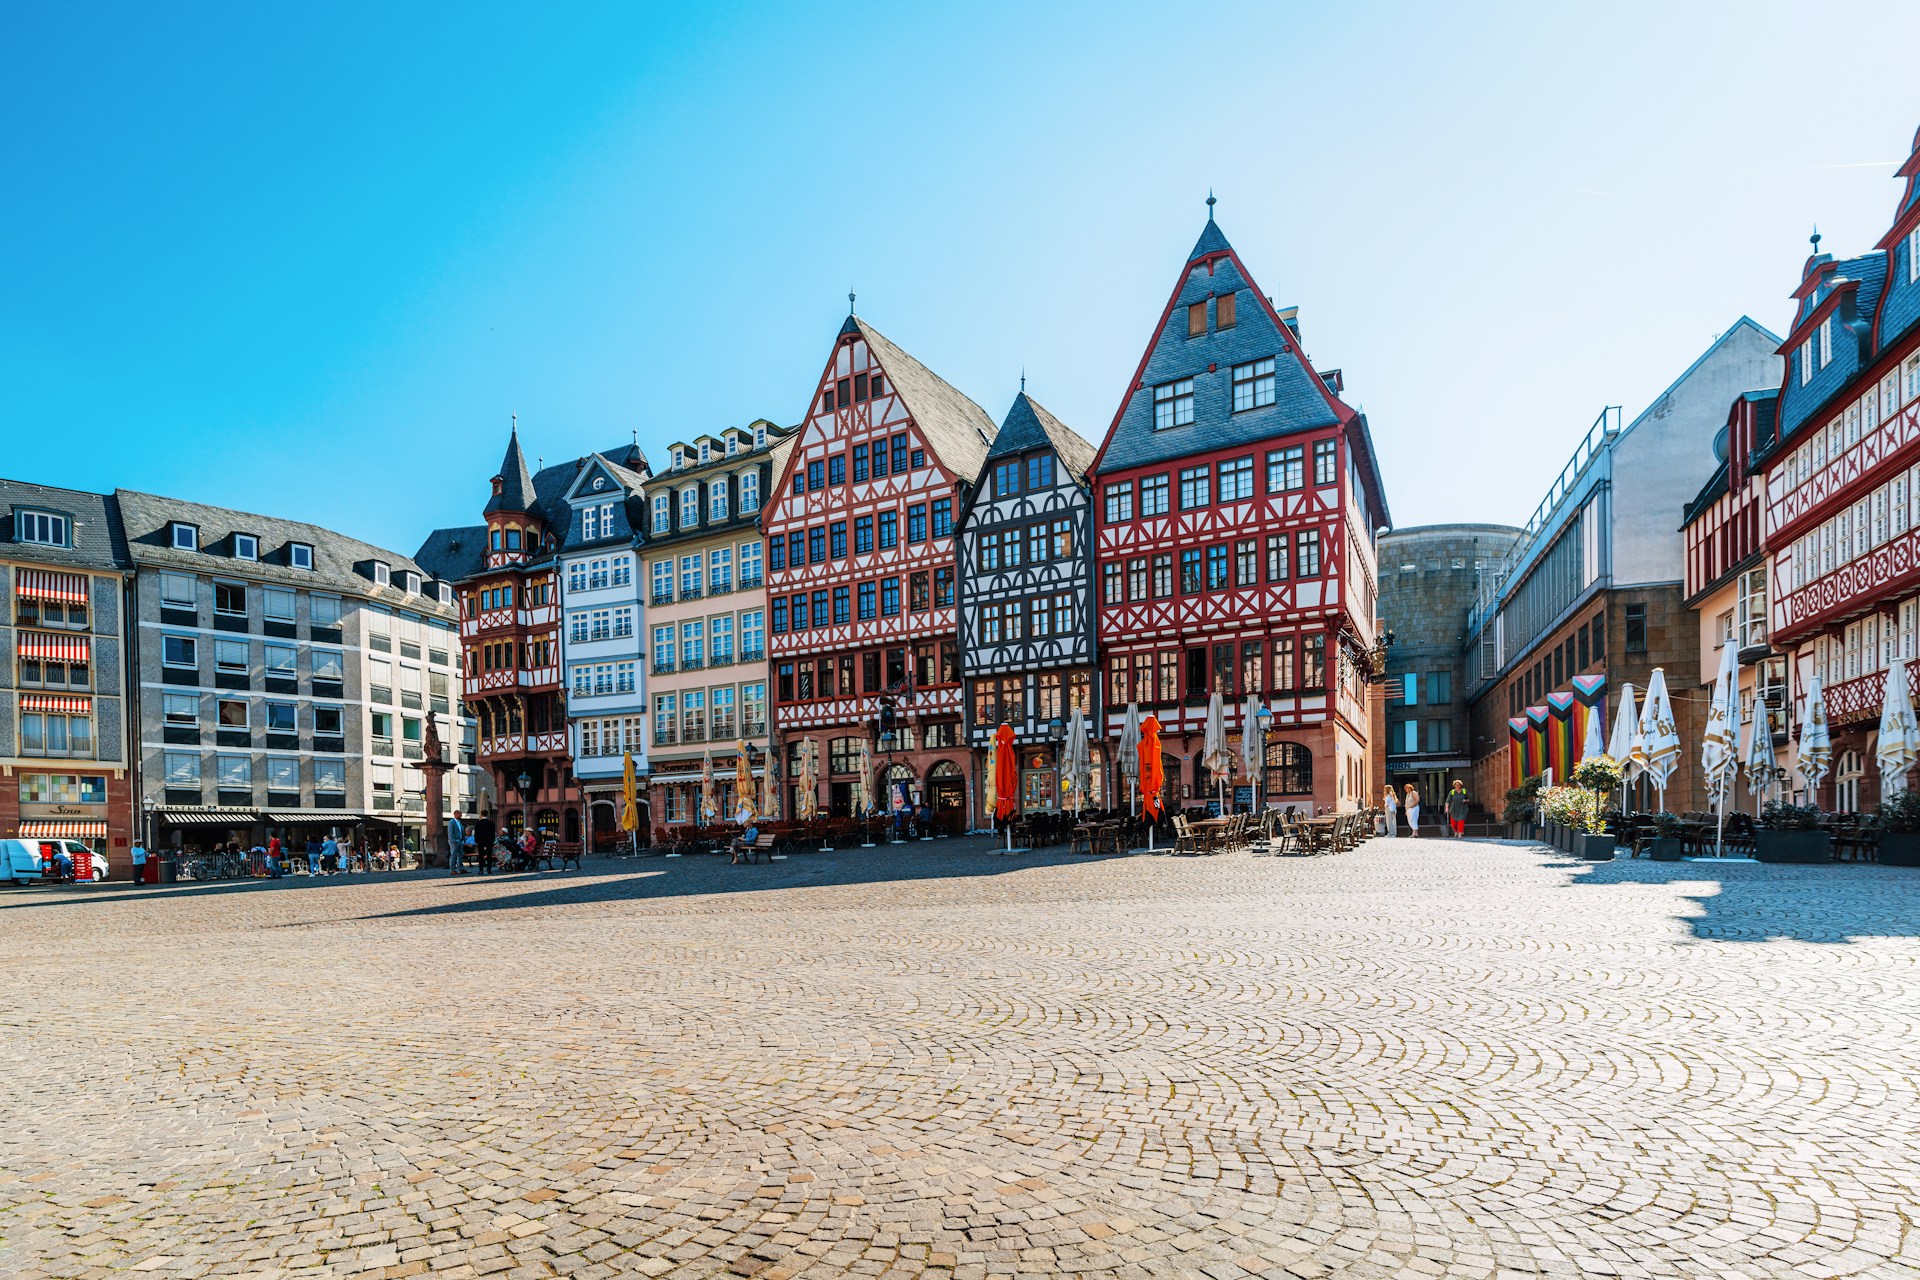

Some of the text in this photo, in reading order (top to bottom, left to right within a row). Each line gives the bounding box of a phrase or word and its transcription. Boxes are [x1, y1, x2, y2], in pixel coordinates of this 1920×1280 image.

[661, 763, 700, 773] Souvenirs
[1386, 762, 1411, 771] HIRN
[49, 805, 81, 815] Sinn
